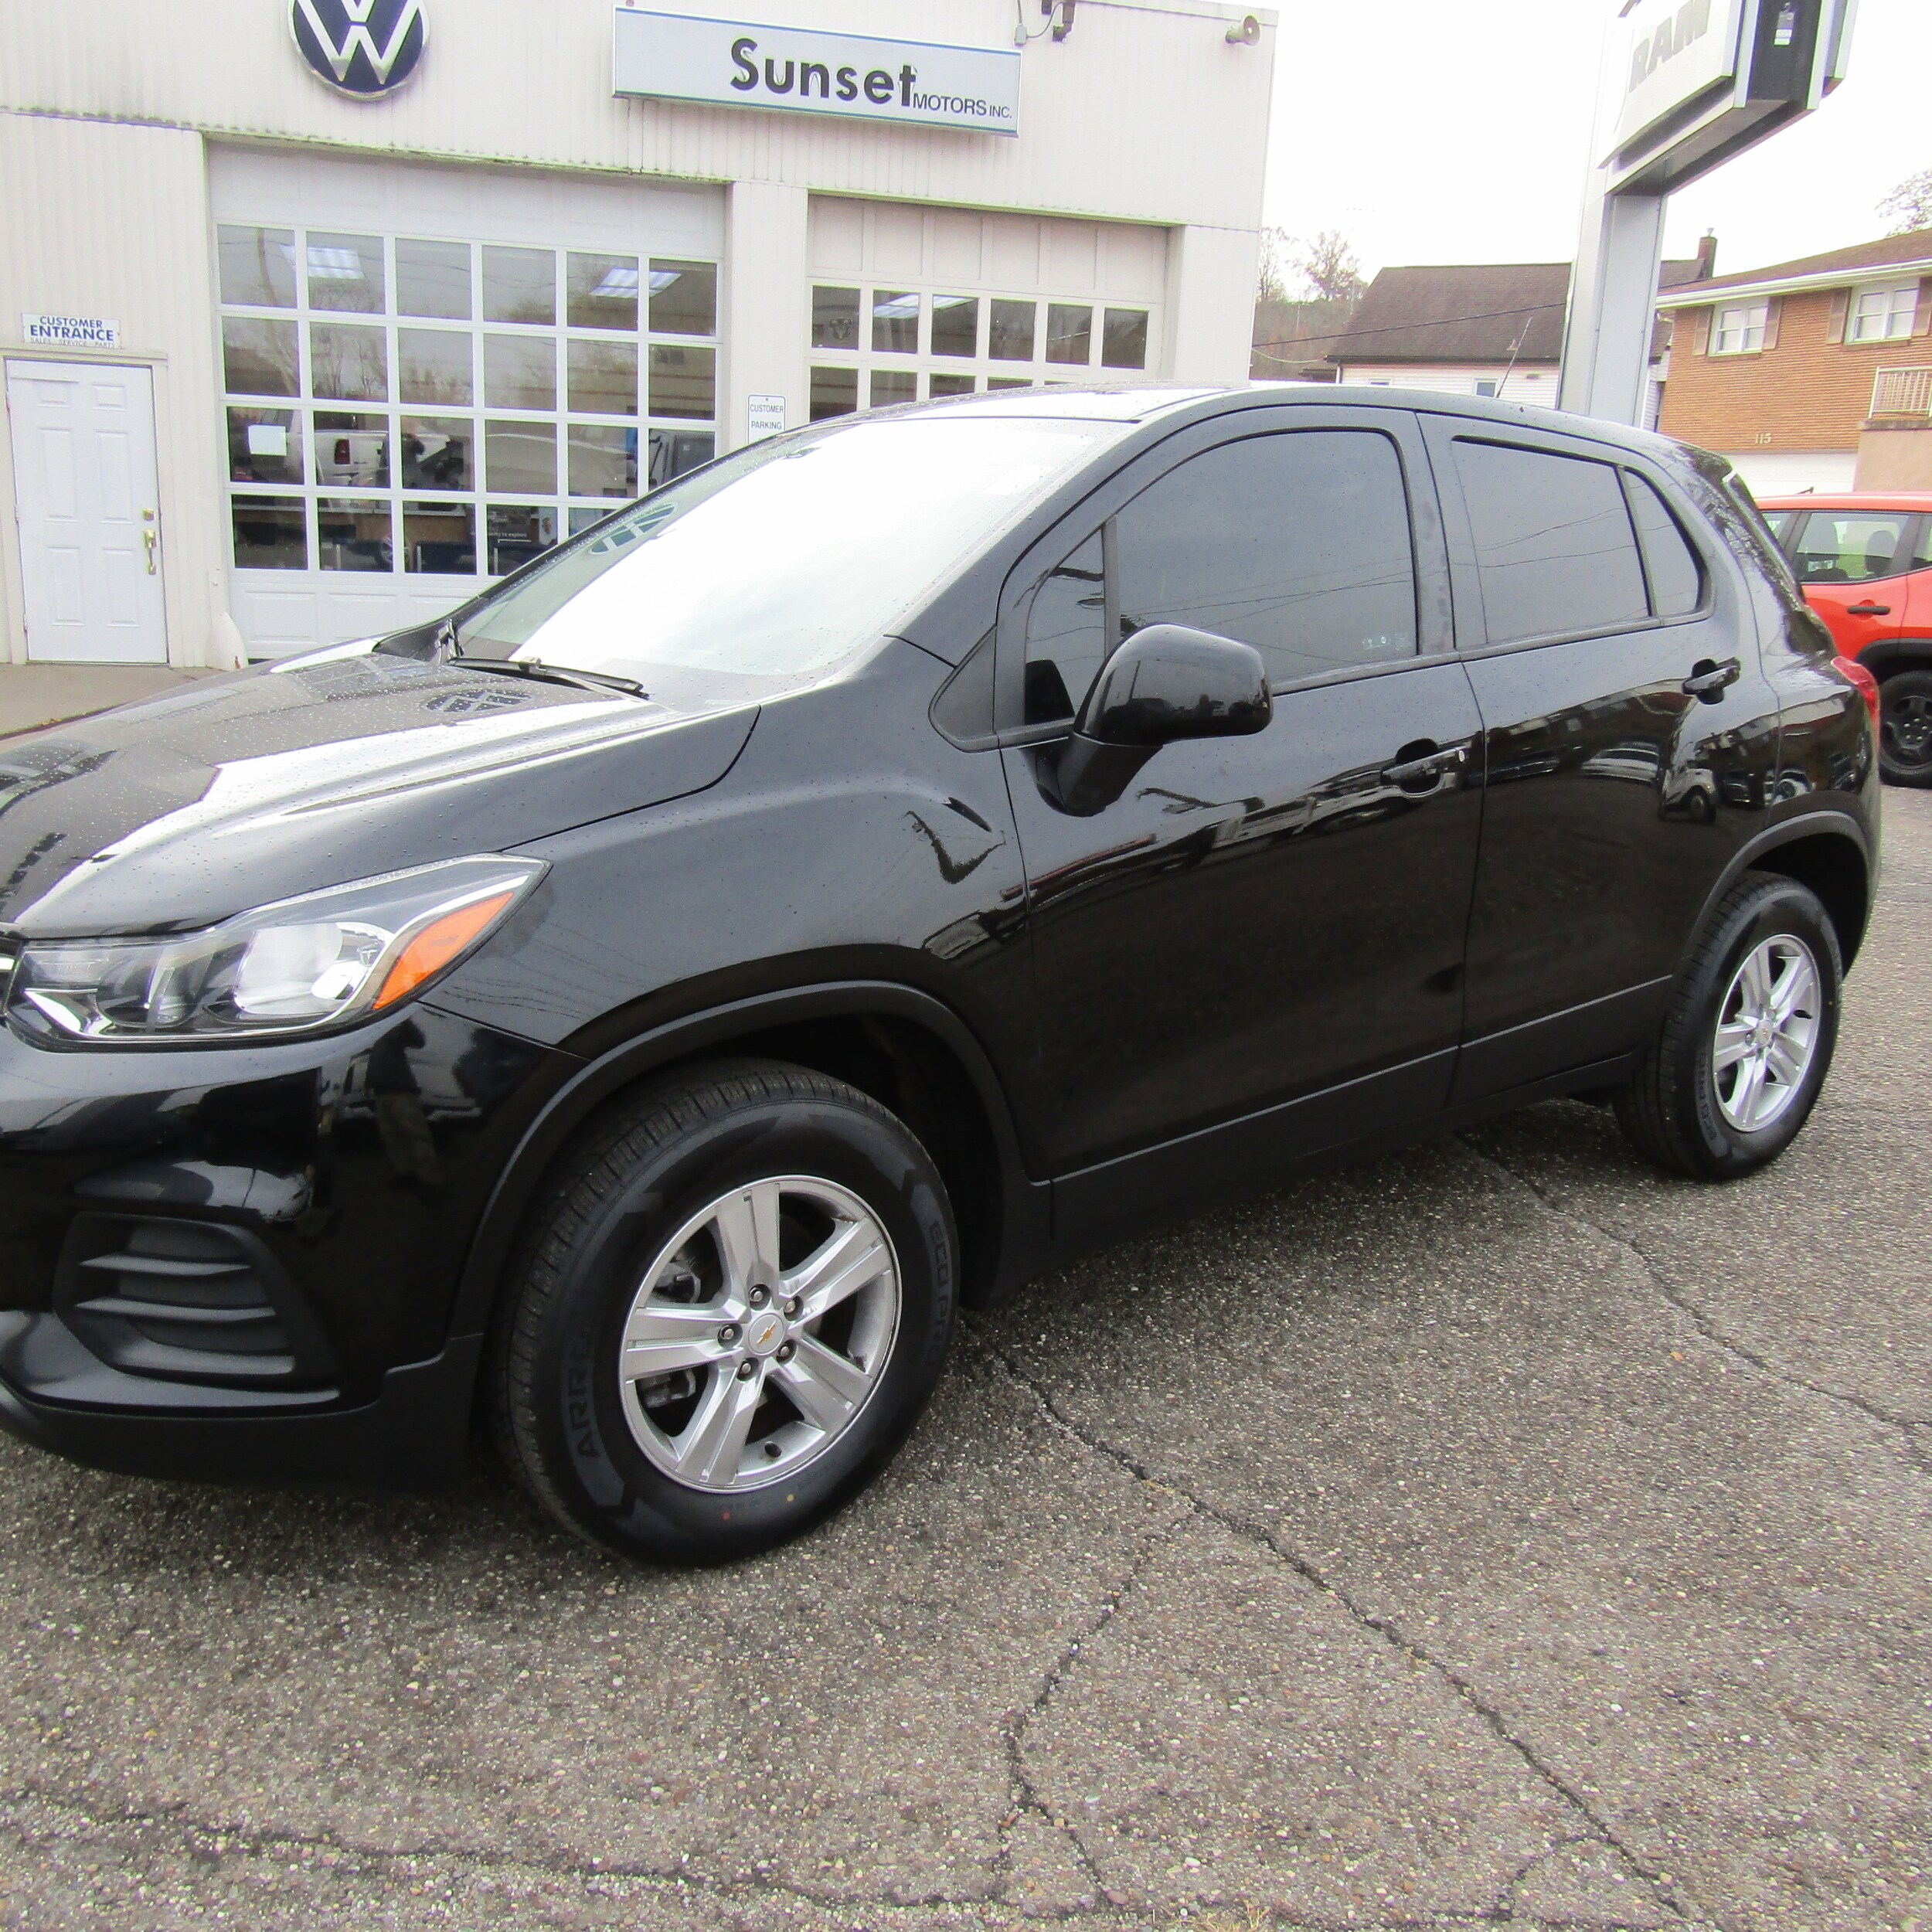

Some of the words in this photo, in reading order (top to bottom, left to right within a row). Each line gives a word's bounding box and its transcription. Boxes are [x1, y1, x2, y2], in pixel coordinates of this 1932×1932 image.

[1628, 0, 1712, 93] RAM
[730, 37, 917, 107] Sunset
[913, 93, 987, 116] MOTORS
[989, 105, 1012, 119] INC.
[39, 315, 103, 328] CUSTOMER
[29, 325, 114, 341] ENTRANCE
[750, 403, 784, 413] CUSTOMER
[751, 420, 782, 430] PARKING
[1755, 433, 1771, 444] 115
